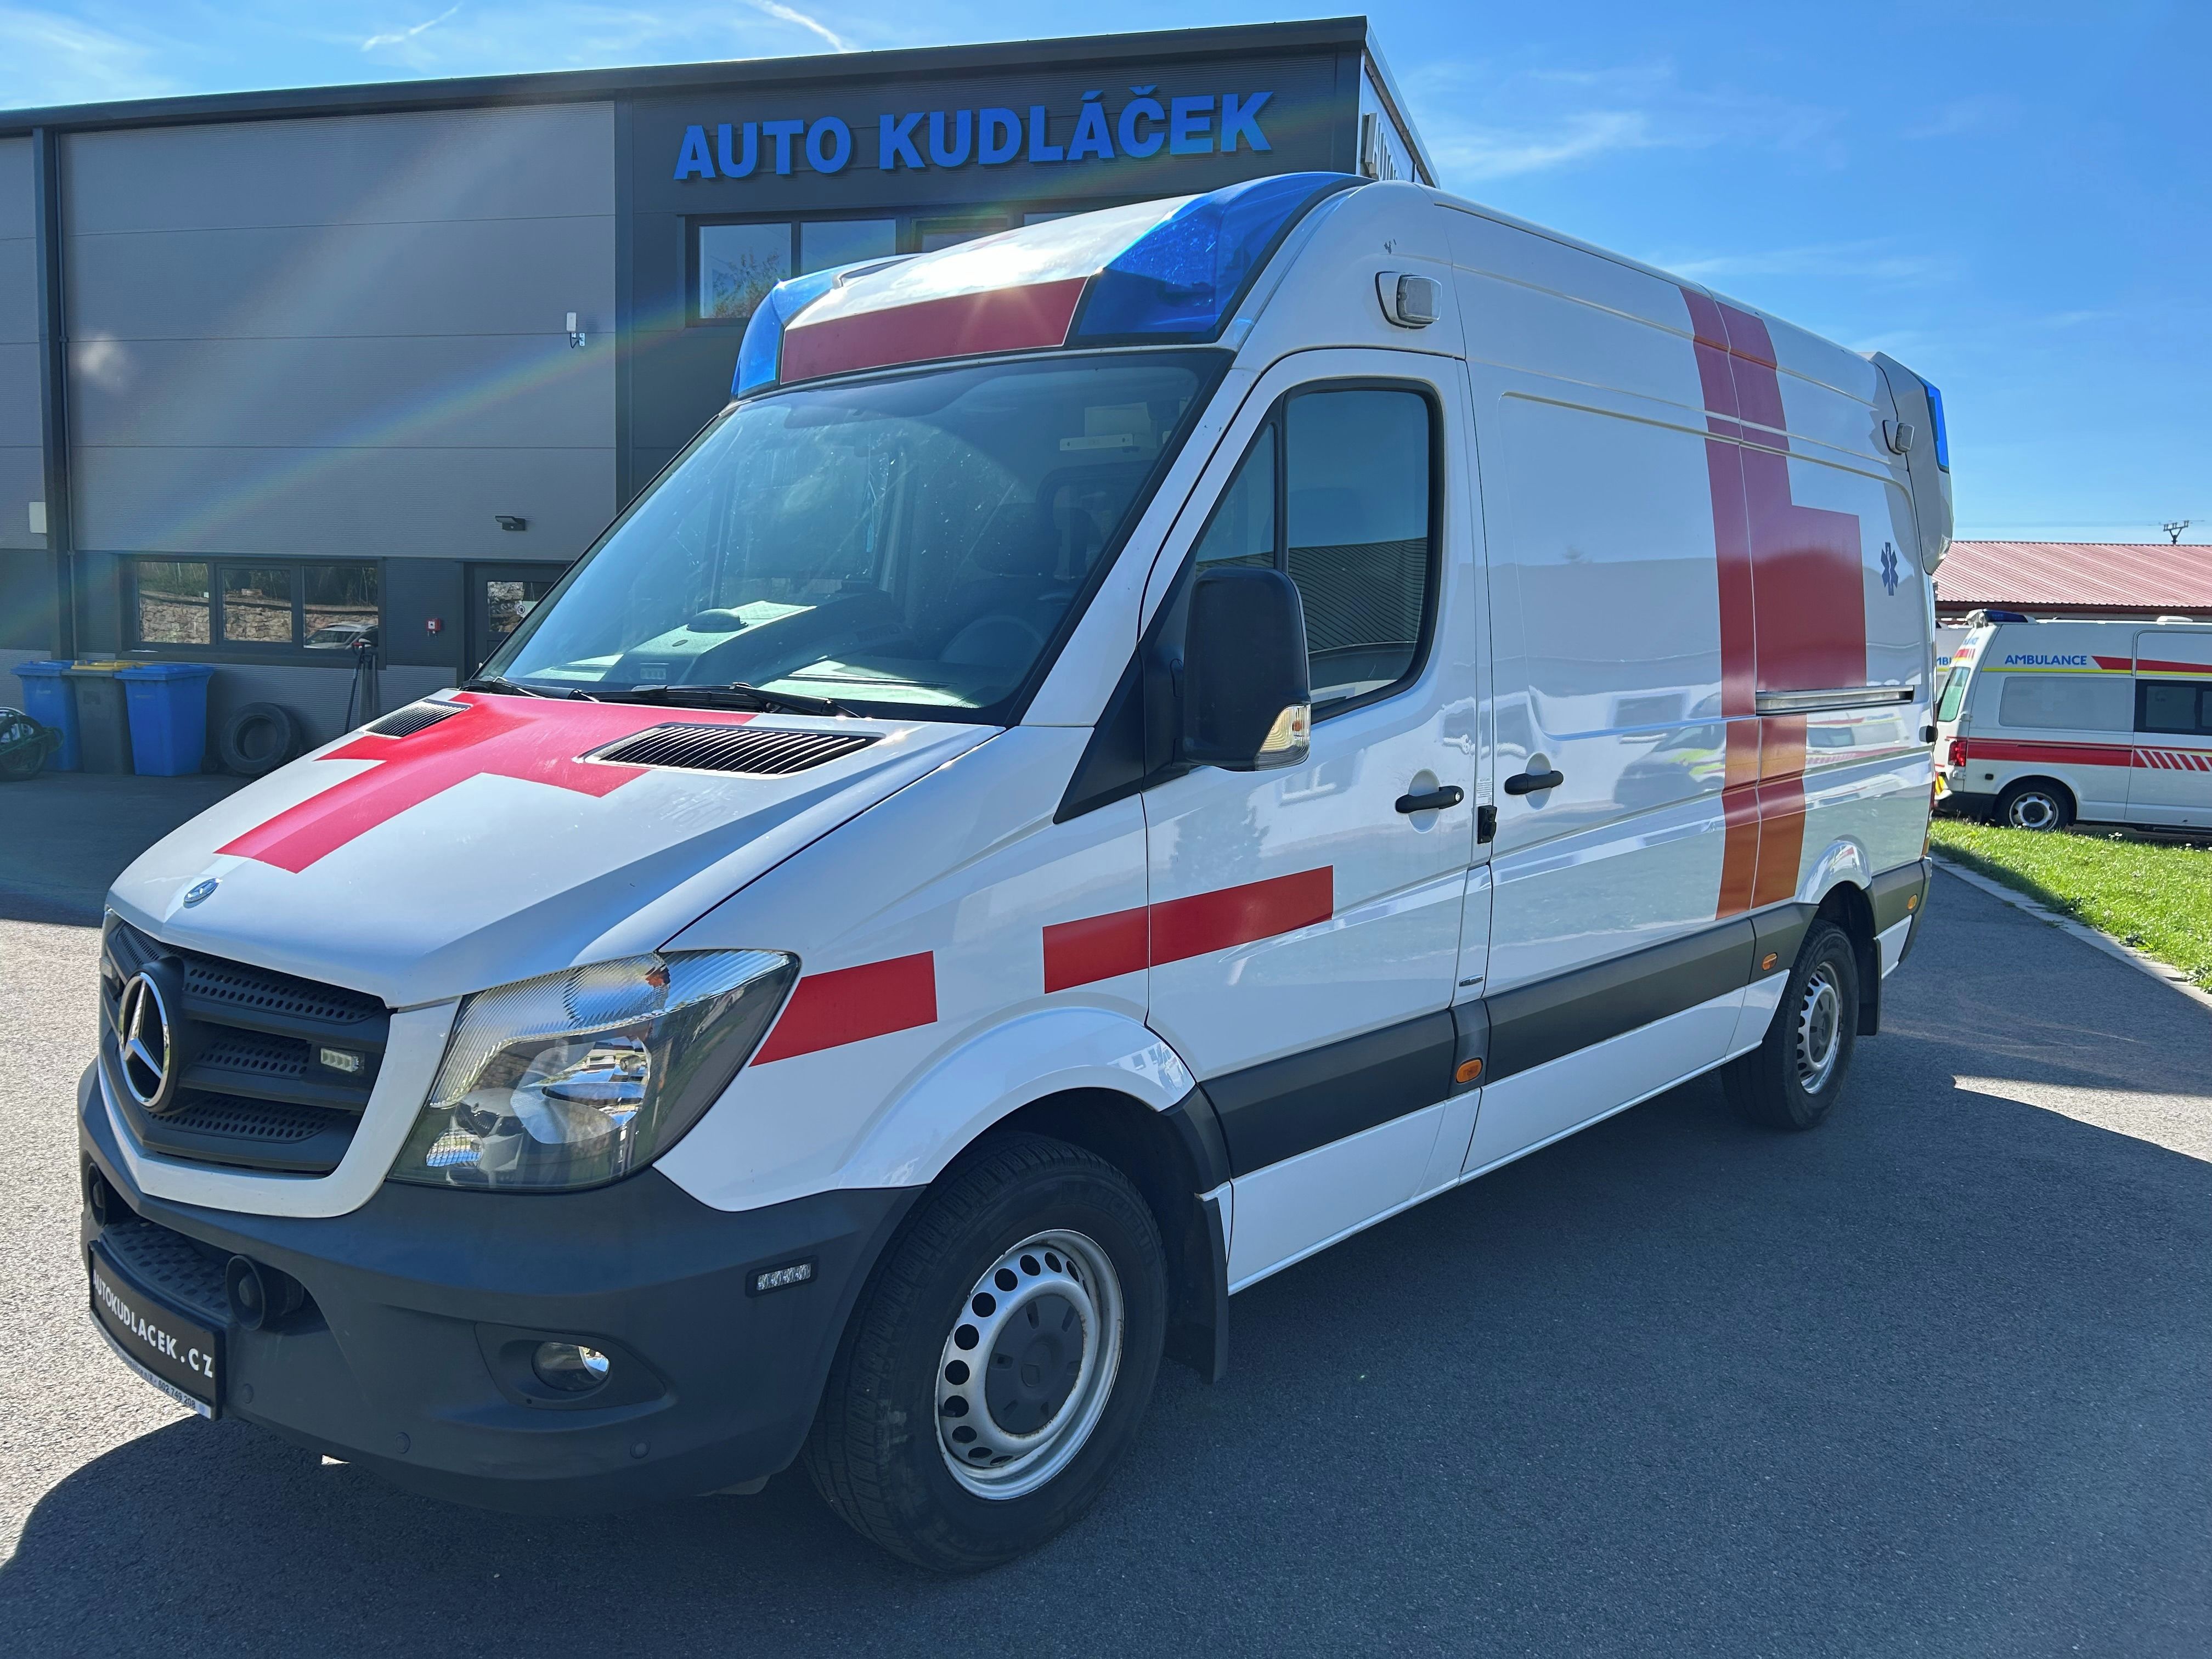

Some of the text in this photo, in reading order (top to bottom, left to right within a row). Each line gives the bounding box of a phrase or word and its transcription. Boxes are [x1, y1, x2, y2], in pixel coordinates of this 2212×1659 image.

[674, 85, 1273, 180] AUTO KUDLÁČEK
[2005, 654, 2087, 665] AMBULANCE
[93, 1269, 213, 1378] AUTOKUDLACEK.CZ
